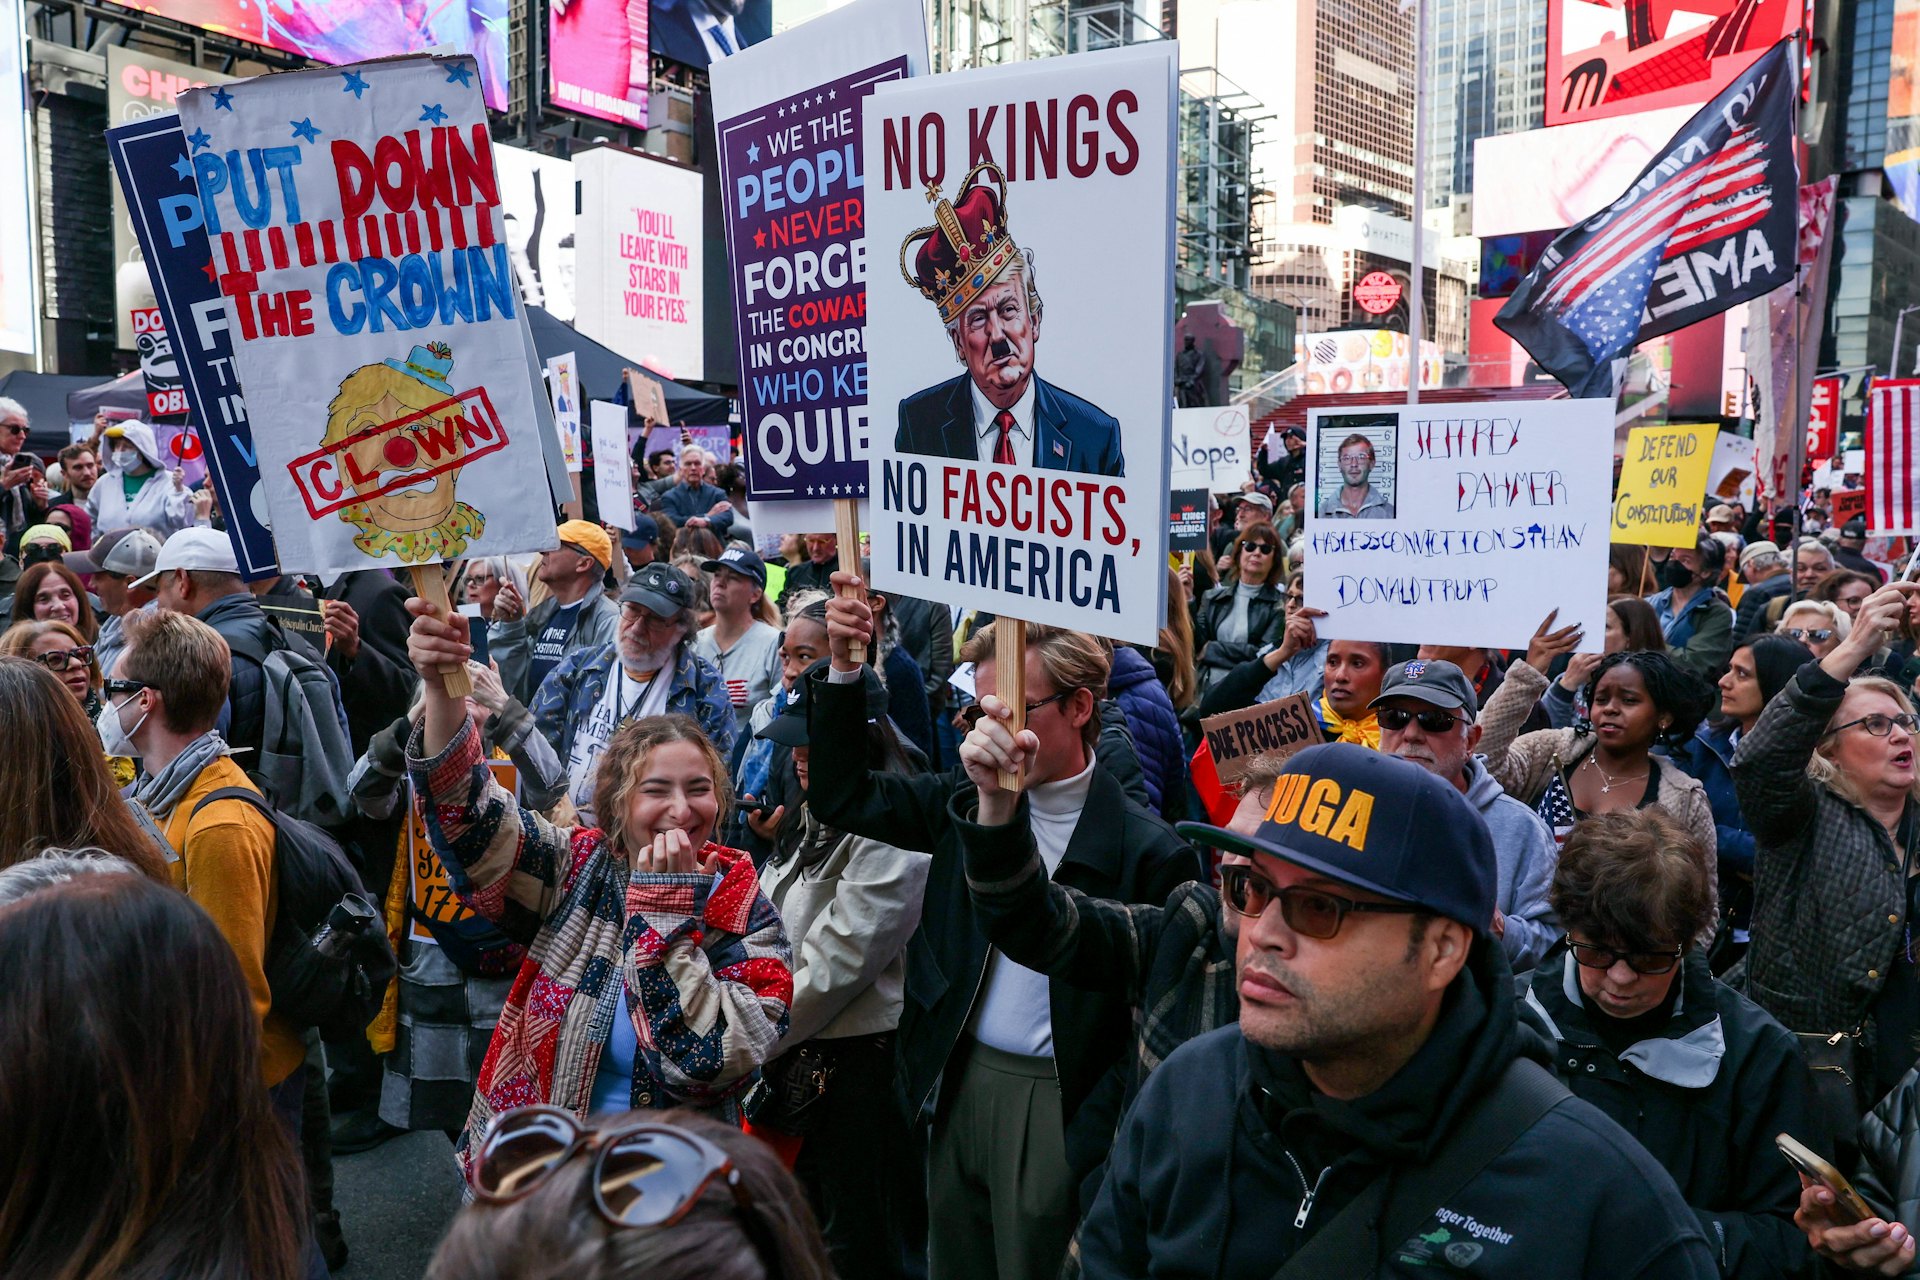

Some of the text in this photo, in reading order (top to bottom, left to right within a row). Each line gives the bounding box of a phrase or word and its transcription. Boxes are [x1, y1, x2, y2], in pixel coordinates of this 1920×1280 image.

[558, 80, 641, 121] NOW ON BROADWAY
[767, 107, 854, 158] WE THE
[883, 89, 1140, 191] NO KINGS
[192, 145, 302, 235] PUT
[331, 123, 500, 219] DOWN
[737, 143, 864, 219] PEOPL
[771, 198, 863, 249] NEVER
[620, 233, 687, 270] LEAVE WITH
[744, 237, 866, 305] FORGE
[220, 271, 315, 341] THE
[326, 242, 515, 336] CROWN
[629, 263, 680, 295] STARS IN
[624, 290, 655, 319] YOUR
[748, 307, 785, 336] THE
[750, 341, 772, 368] IN
[753, 369, 824, 406] WHO
[1171, 434, 1239, 481] Nope.
[1408, 418, 1521, 461] JEFFREY
[1638, 433, 1697, 462] DEFEND
[1457, 470, 1568, 512] DAHMER
[1650, 466, 1677, 488] OUR
[883, 459, 1140, 557] NO FASCISTS,
[1170, 524, 1205, 533] AMERICA
[1182, 512, 1205, 520] KINGS
[897, 521, 1120, 614] IN AMERICA
[1333, 575, 1498, 608] DONALD TRUMP
[1207, 704, 1309, 764] DUE PROCESS
[1435, 1207, 1514, 1244] nger Together
